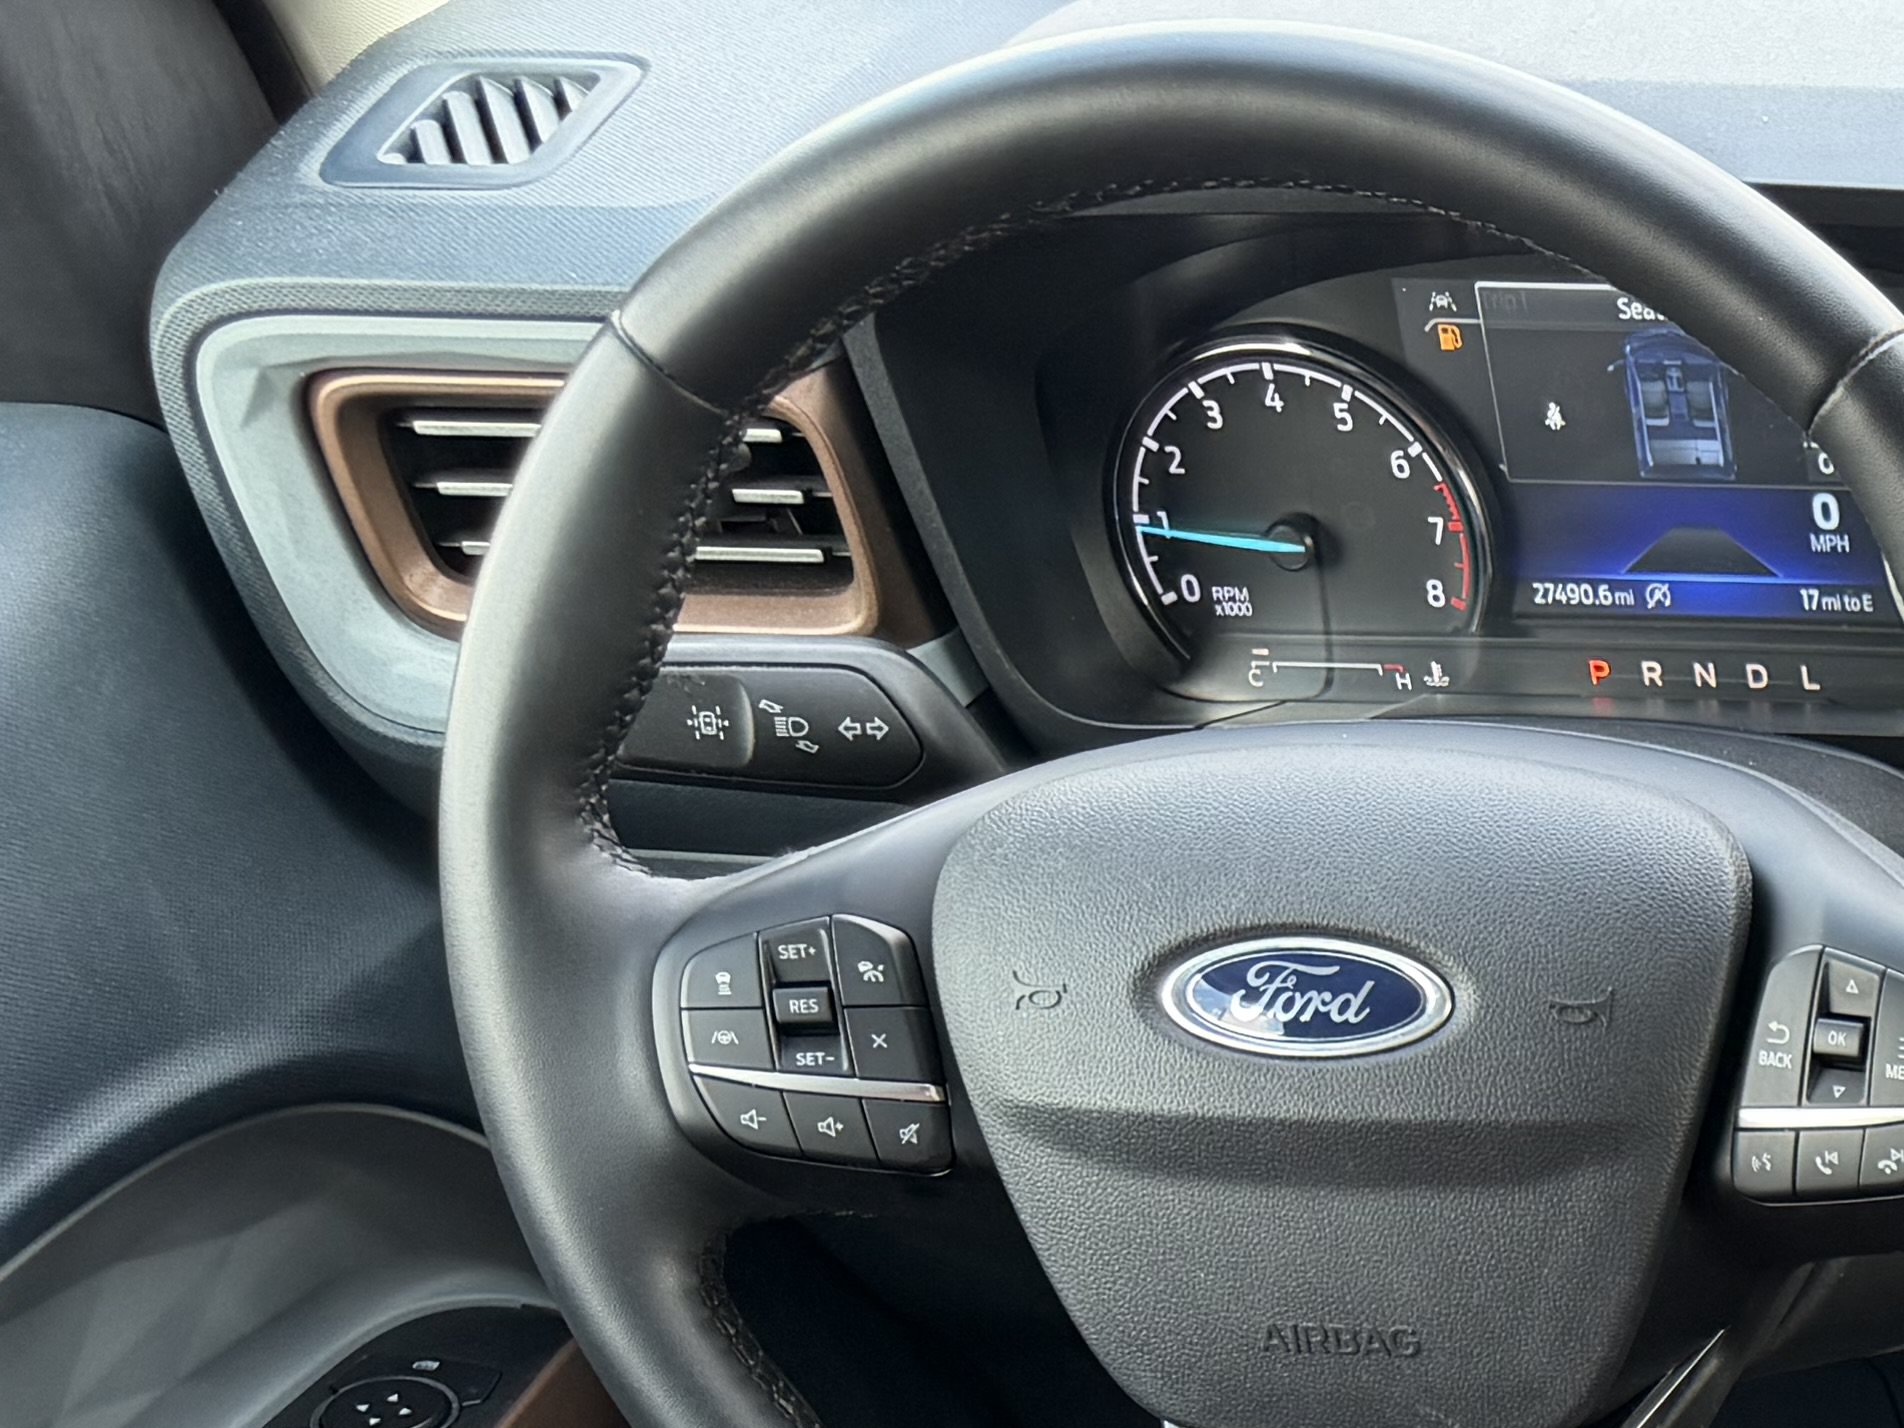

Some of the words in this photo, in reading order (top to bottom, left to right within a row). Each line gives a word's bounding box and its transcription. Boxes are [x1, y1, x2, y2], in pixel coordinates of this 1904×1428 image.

[1616, 296, 1666, 321] Sea
[1264, 383, 1284, 413] 4
[1202, 400, 1223, 429] 3
[1333, 402, 1353, 432] 5
[1164, 446, 1186, 474] 2
[1390, 450, 1410, 479] 6
[1812, 492, 1840, 530] 0
[1428, 516, 1444, 545] 7
[1809, 534, 1849, 553] MPH
[1180, 574, 1201, 602] 0
[1212, 586, 1249, 602] RPM
[1426, 579, 1446, 609] 8
[1215, 601, 1252, 617] x1000
[1395, 672, 1413, 691] H
[1588, 659, 1611, 686] P
[1641, 660, 1664, 687] R
[1692, 661, 1717, 688] N
[1746, 663, 1769, 689] D
[1800, 664, 1821, 691] L
[778, 943, 816, 959] SET+
[789, 998, 819, 1014] RES
[1228, 958, 1376, 1026] Ford
[1827, 1029, 1847, 1047] OK
[1758, 1051, 1792, 1069] BACK
[1261, 1322, 1421, 1361] AIRBAG
